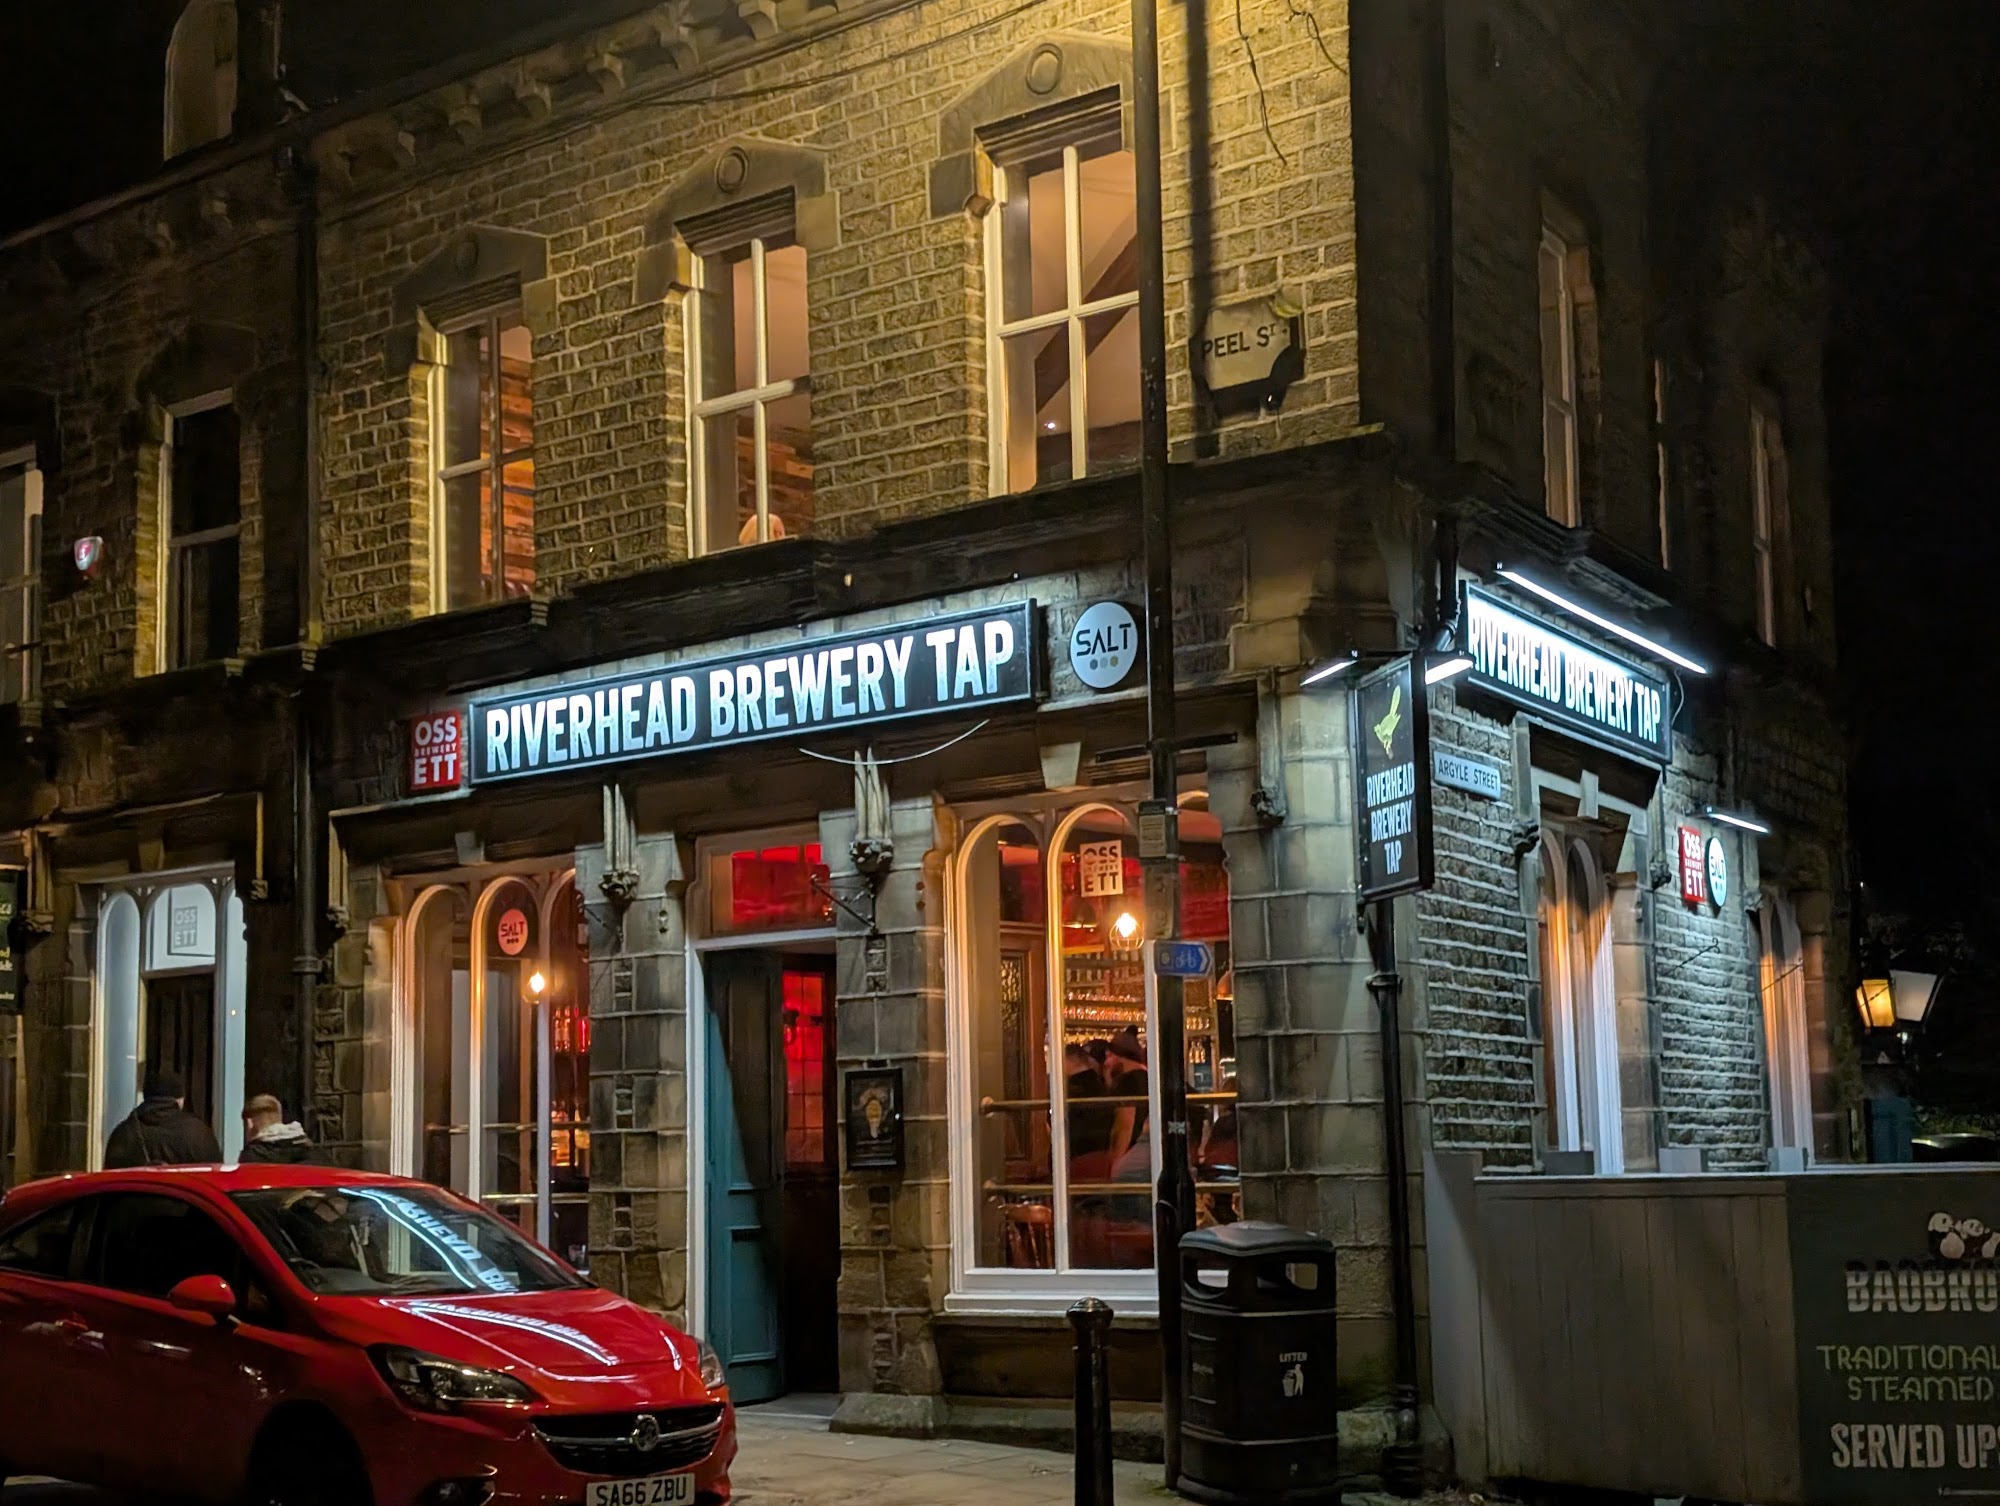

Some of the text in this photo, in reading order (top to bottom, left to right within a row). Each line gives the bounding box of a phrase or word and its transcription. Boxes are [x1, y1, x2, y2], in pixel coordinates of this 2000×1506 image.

[1202, 331, 1250, 360] PEEL
[1076, 622, 1132, 657] SALT
[1468, 612, 1661, 744] RIVERHEAD BREWERY TAP
[486, 619, 1014, 773] RIVERHEAD BREWERY TAP
[415, 716, 457, 746] OSS
[414, 742, 457, 757] BREWERY
[414, 753, 457, 785] ETT
[1438, 758, 1498, 790] ARGYLE STREET
[1366, 761, 1415, 808] RIVERHEAD
[1370, 799, 1413, 843] BREWERY
[1383, 840, 1402, 875] TAP
[1684, 831, 1701, 861] OSS
[1084, 872, 1119, 892] ETT
[1685, 868, 1703, 898] ETT
[501, 921, 525, 938] SALT
[1816, 1344, 2000, 1370] TRADITIONAL
[1848, 1375, 1994, 1402] STEAMED
[1831, 1422, 2000, 1469] SERVED UP
[596, 1476, 687, 1506] SA66 ZBU
